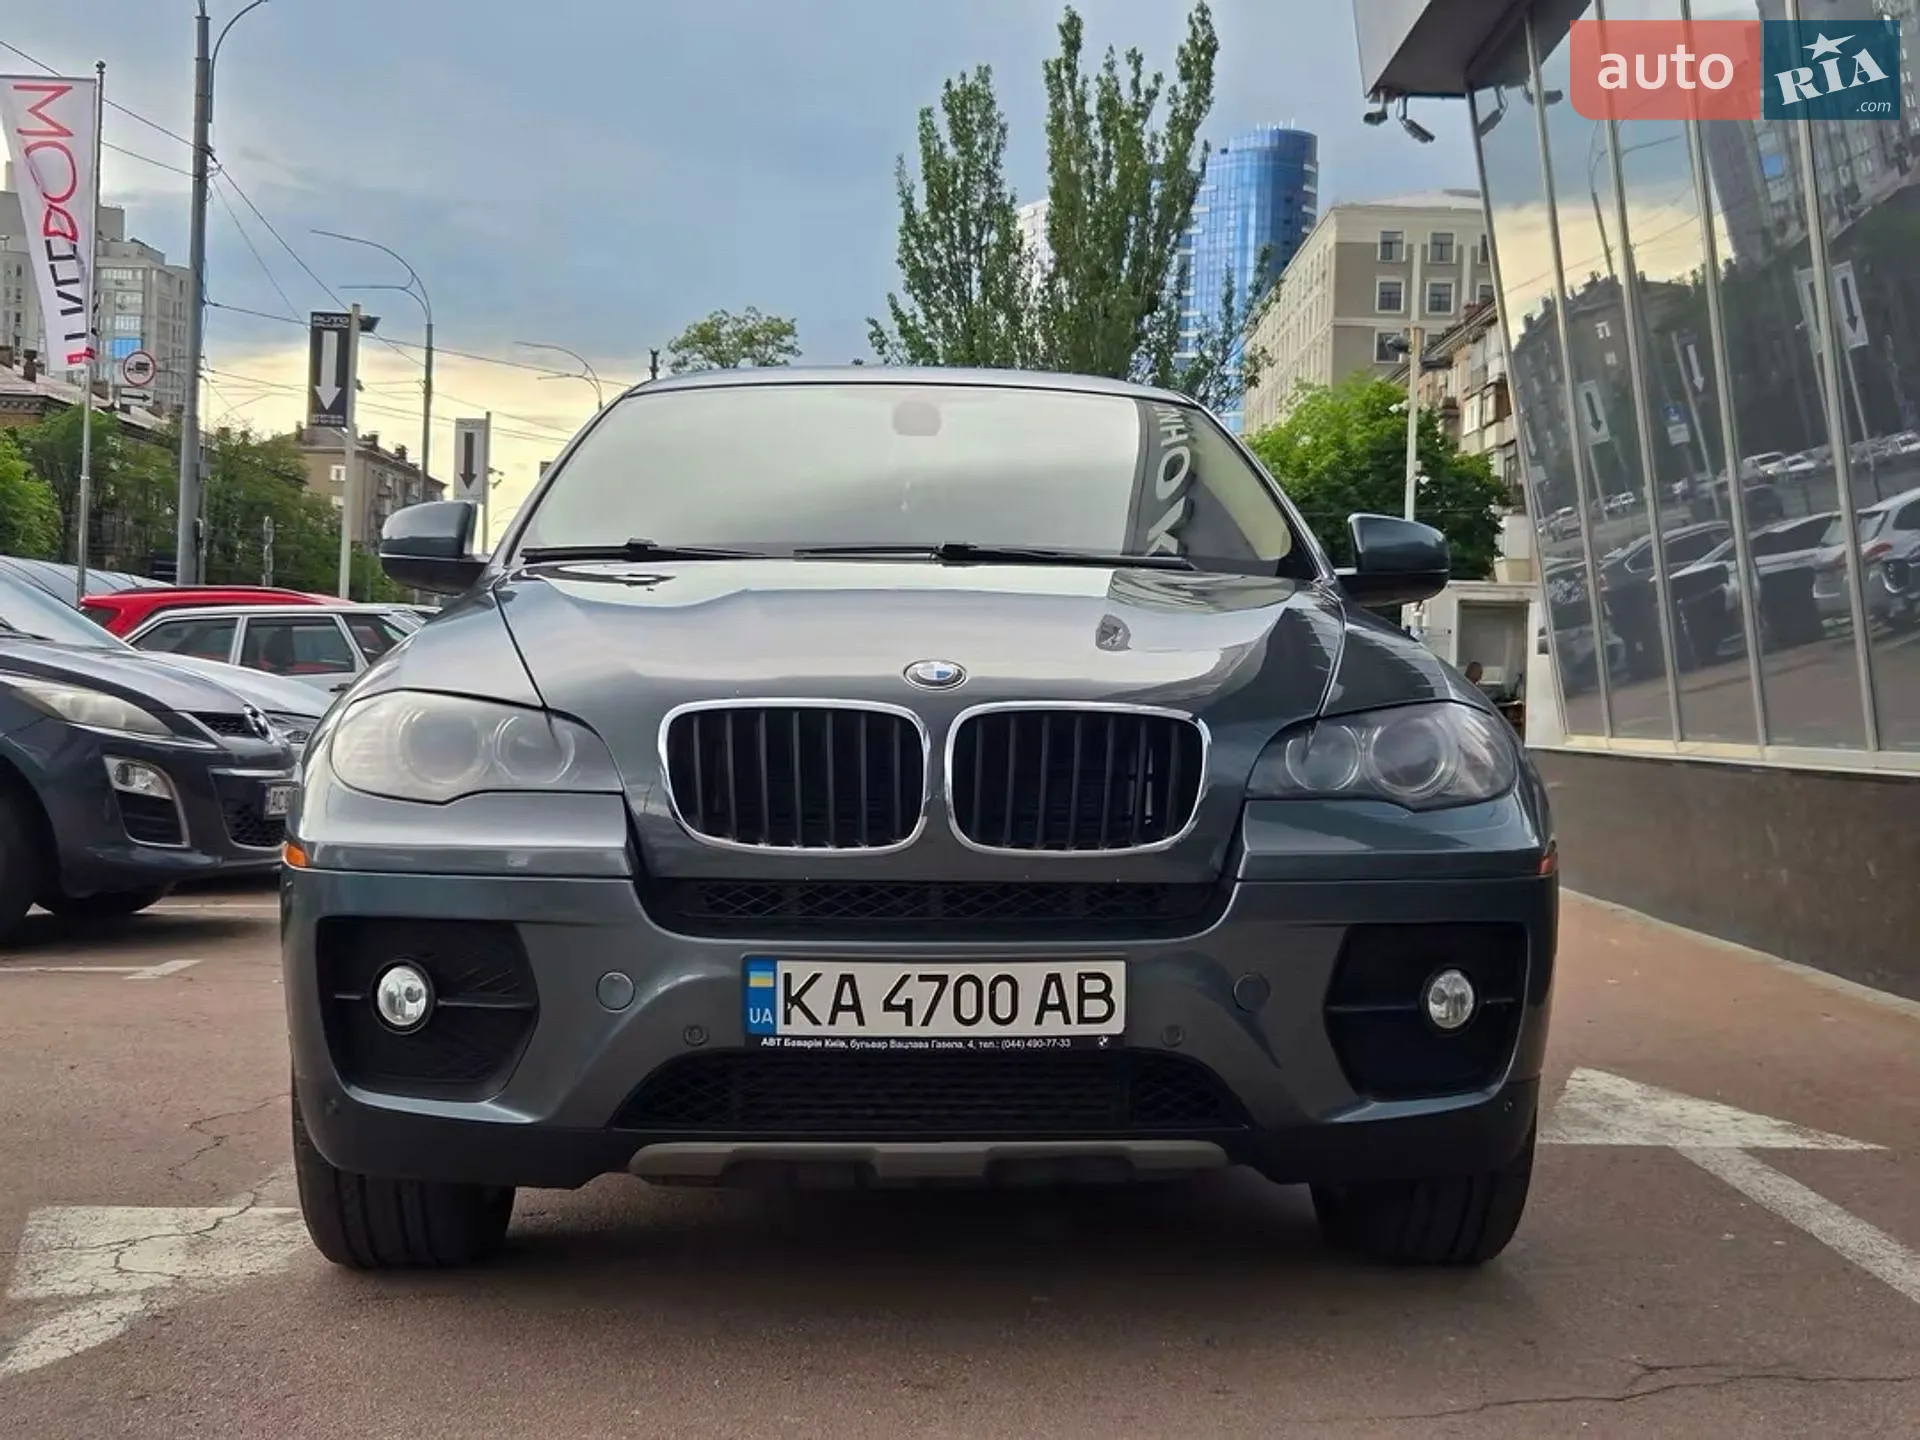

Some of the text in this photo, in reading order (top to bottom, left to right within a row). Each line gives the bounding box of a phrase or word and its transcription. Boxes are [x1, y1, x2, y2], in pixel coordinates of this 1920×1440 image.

[749, 1008, 774, 1024] UA
[783, 971, 1116, 1028] KA 4700 AB
